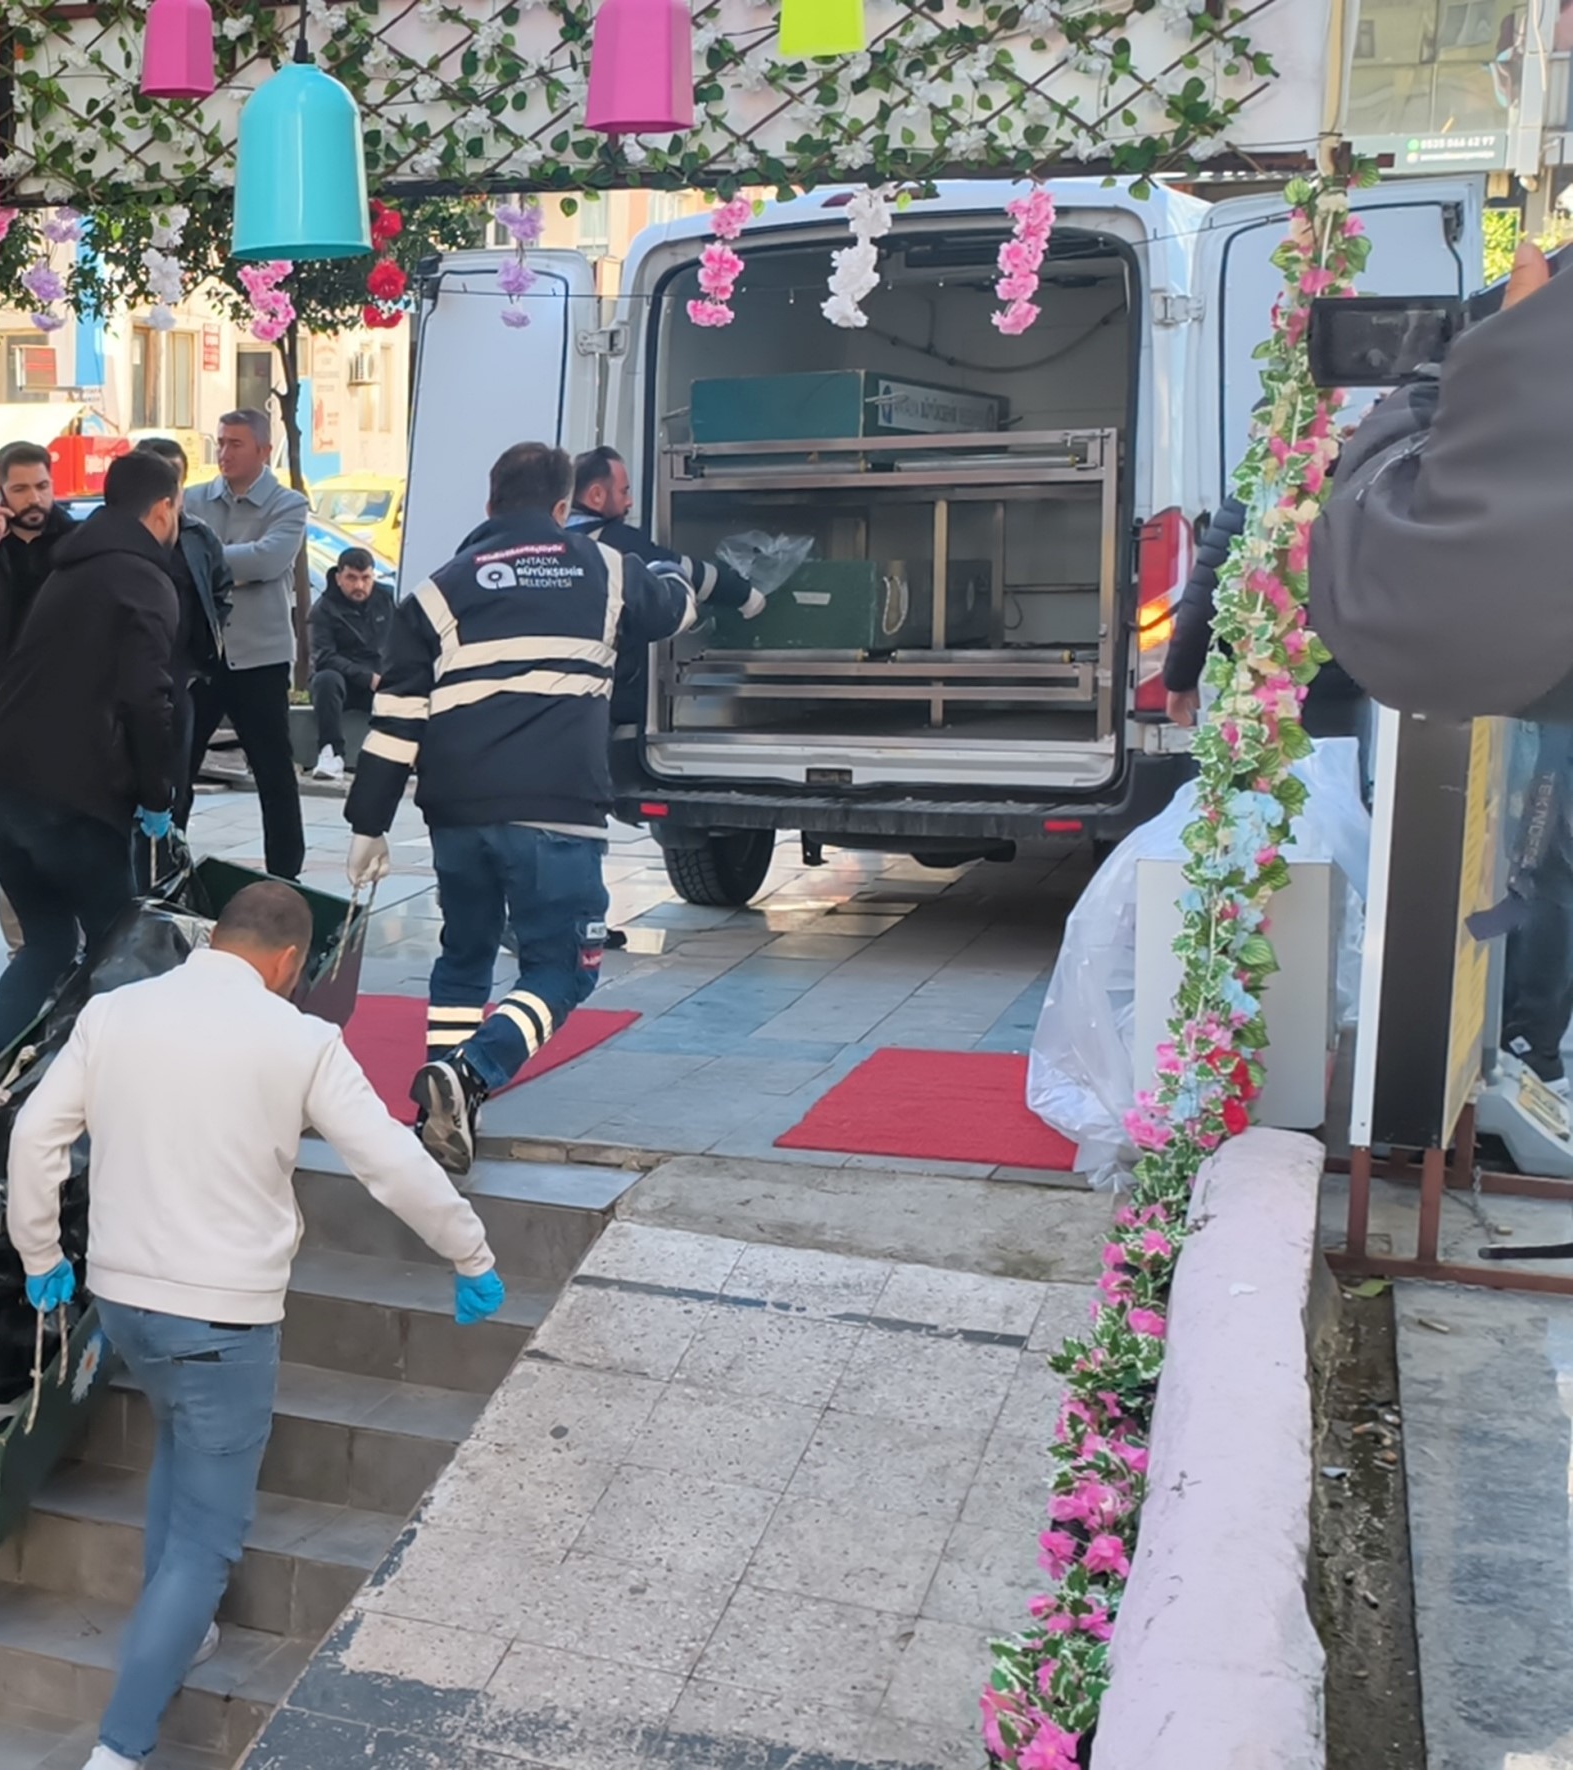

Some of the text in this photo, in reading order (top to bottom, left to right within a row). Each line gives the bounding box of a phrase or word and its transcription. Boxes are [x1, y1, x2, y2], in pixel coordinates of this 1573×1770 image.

[515, 556, 560, 567] ANTALYA
[516, 565, 585, 578] BÜYÜKŞEHİR
[519, 576, 573, 588] BELEDİYESİ
